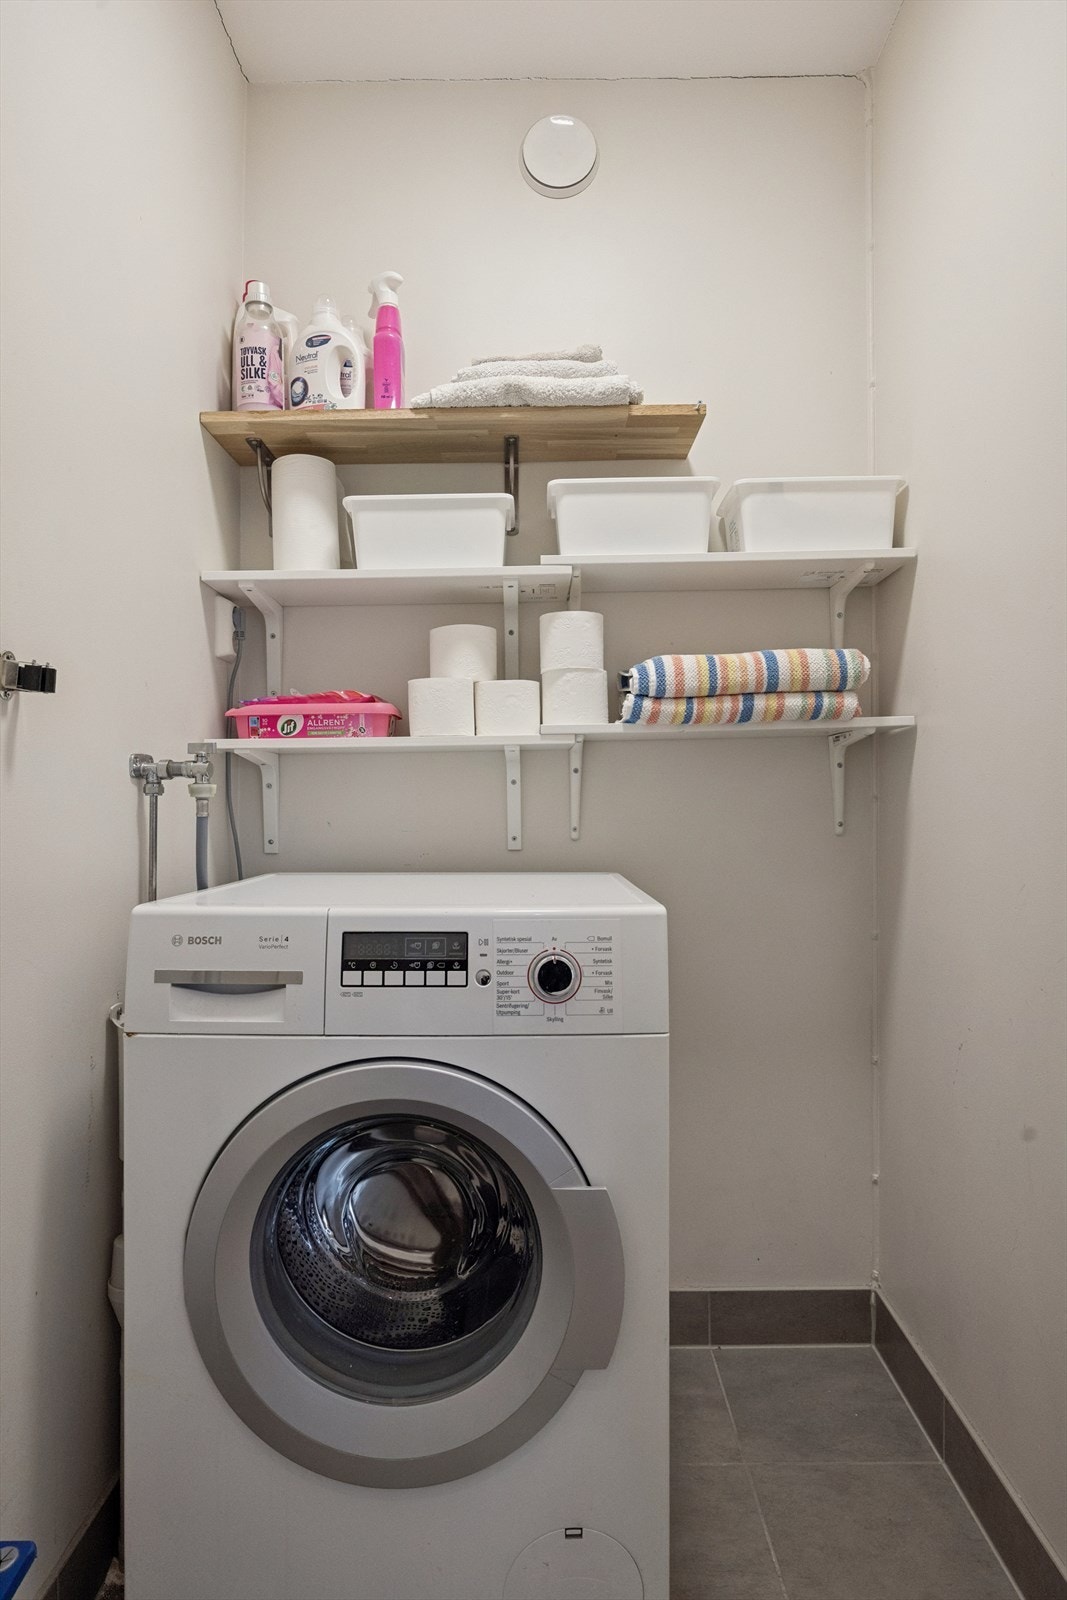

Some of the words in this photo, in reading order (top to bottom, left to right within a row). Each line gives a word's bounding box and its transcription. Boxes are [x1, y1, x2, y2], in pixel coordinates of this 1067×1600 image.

[240, 346, 267, 356] TØYVASK
[295, 351, 319, 362] Neutral
[240, 355, 256, 368] ULL
[259, 355, 267, 368] &
[240, 367, 266, 380] SILKE
[282, 721, 295, 734] Jif
[187, 936, 222, 945] BOSCH
